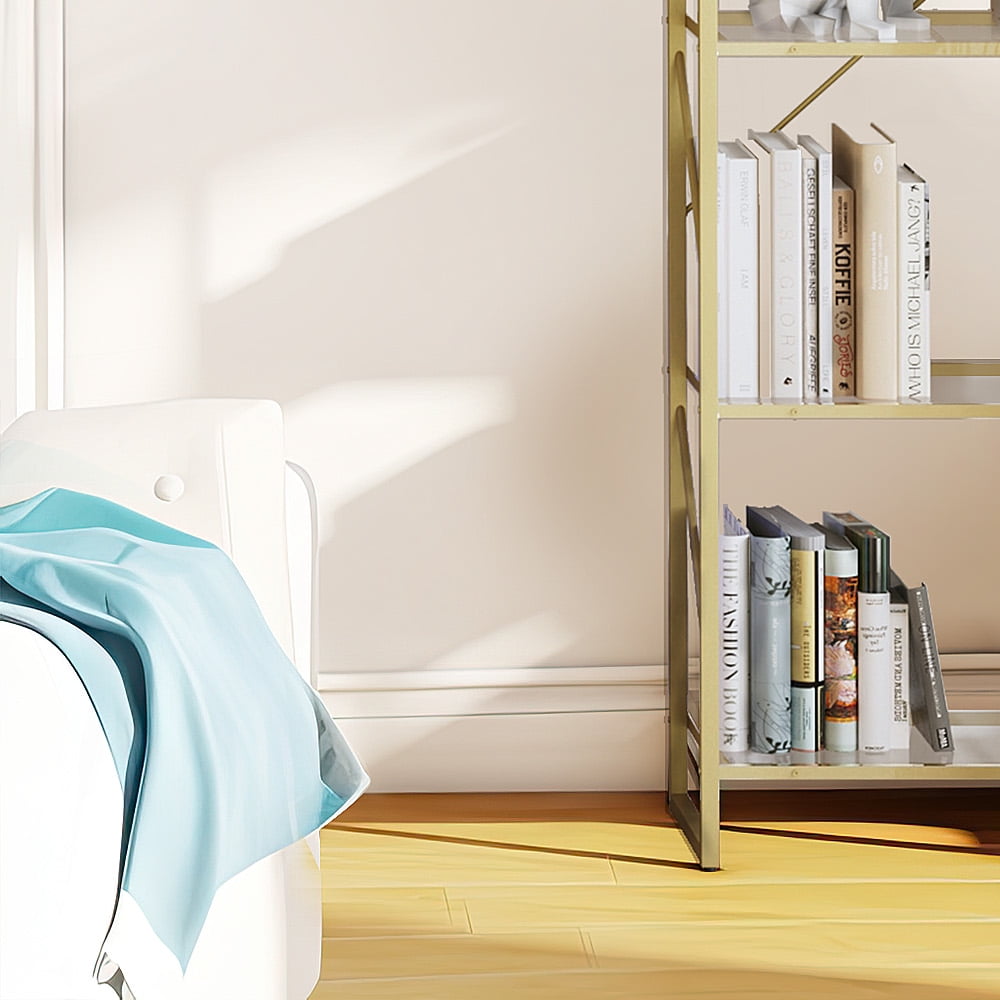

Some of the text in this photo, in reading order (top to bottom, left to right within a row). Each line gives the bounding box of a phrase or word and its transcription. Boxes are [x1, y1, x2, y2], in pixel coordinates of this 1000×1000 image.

[835, 243, 851, 306] KOFFIE
[907, 198, 921, 403] WHO IS MICHAEL JANG?
[723, 543, 738, 745] THE FASHION BOOK
